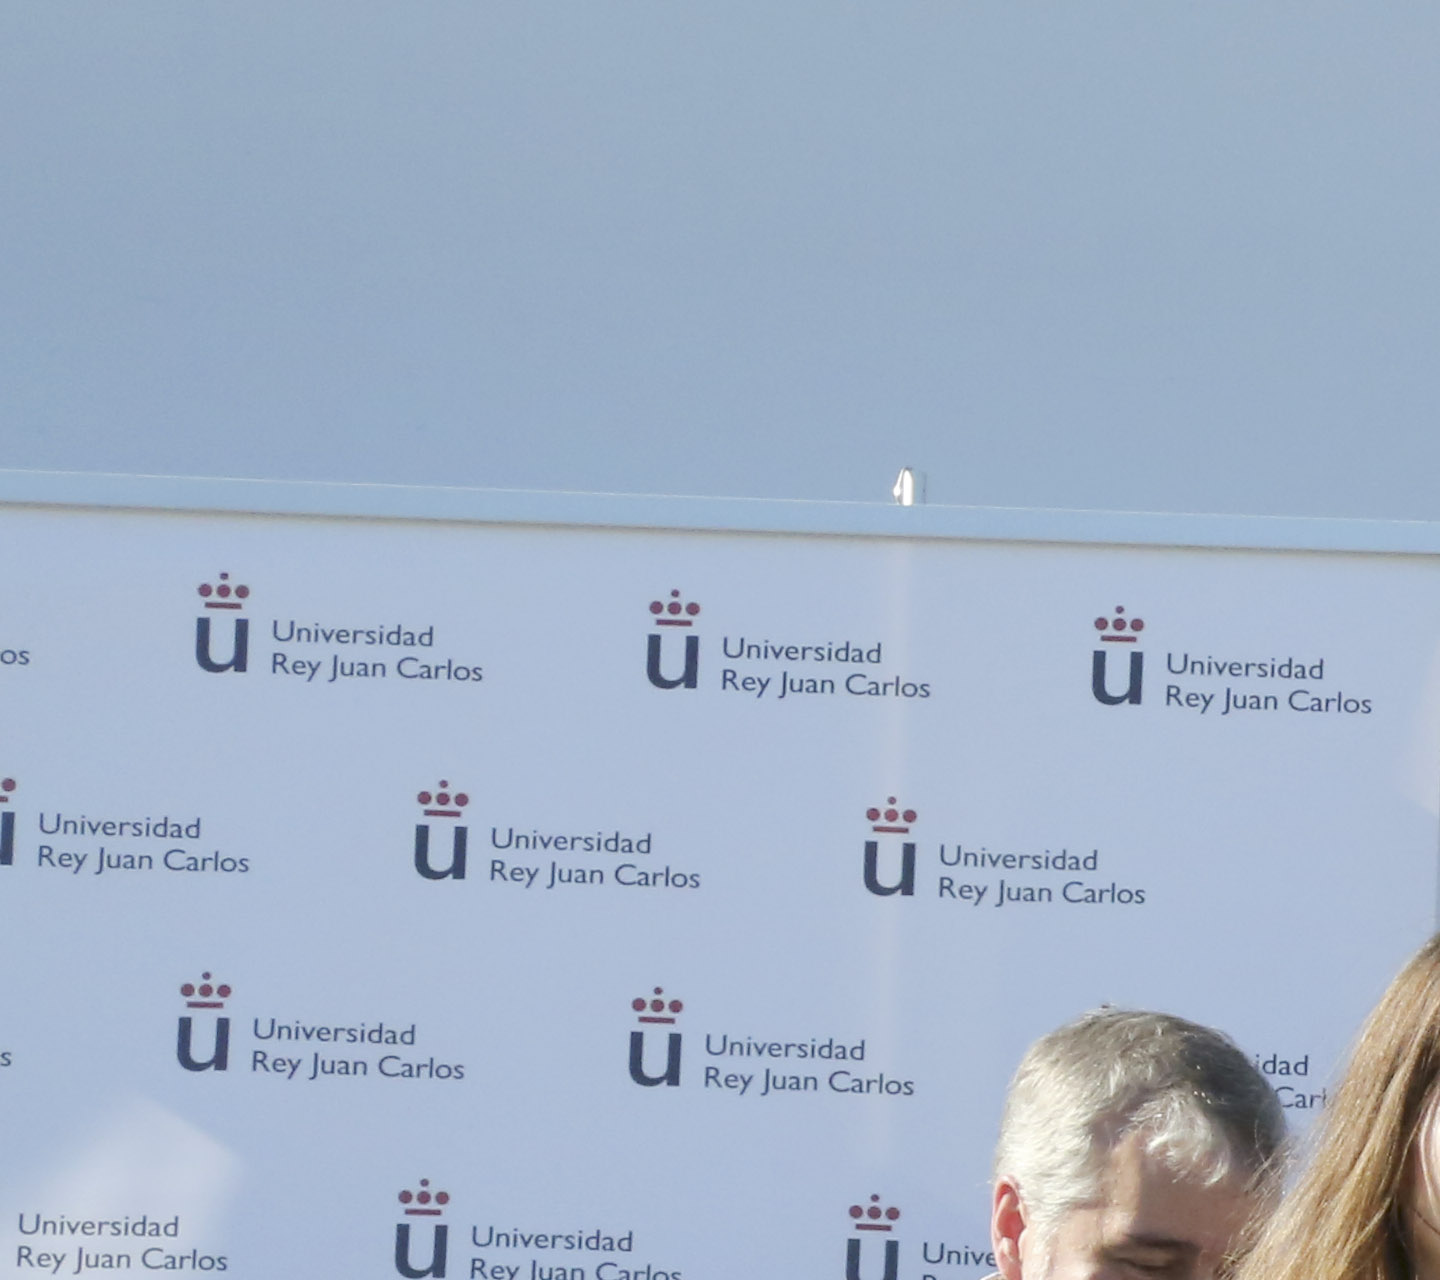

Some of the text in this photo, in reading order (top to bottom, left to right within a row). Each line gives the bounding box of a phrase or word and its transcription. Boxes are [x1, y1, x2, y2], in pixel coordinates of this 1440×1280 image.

[272, 619, 434, 647] Universidad
[722, 636, 882, 664] Universidad
[271, 652, 483, 683] Rey Juan Carlos
[1166, 652, 1324, 680] Universidad
[721, 668, 931, 699] Rey Juan Carlos
[1165, 684, 1372, 716] Rey Juan Carlos
[39, 812, 201, 839] Universidad
[491, 827, 652, 855] Universidad
[37, 844, 250, 876] Rey Juan Carlos
[939, 843, 1098, 871] Universidad
[490, 859, 701, 890] Rey Juan Carlos
[938, 876, 1146, 908] Rey Juan Carlos
[253, 1017, 416, 1046] Universidad
[705, 1033, 866, 1061] Universidad
[252, 1050, 465, 1081] Rey Juan Carlos
[704, 1066, 915, 1097] Rey Juan Carlos
[18, 1212, 180, 1238] Universidad
[471, 1225, 633, 1253] Universidad
[16, 1245, 228, 1276] Rey Juan Carlos
